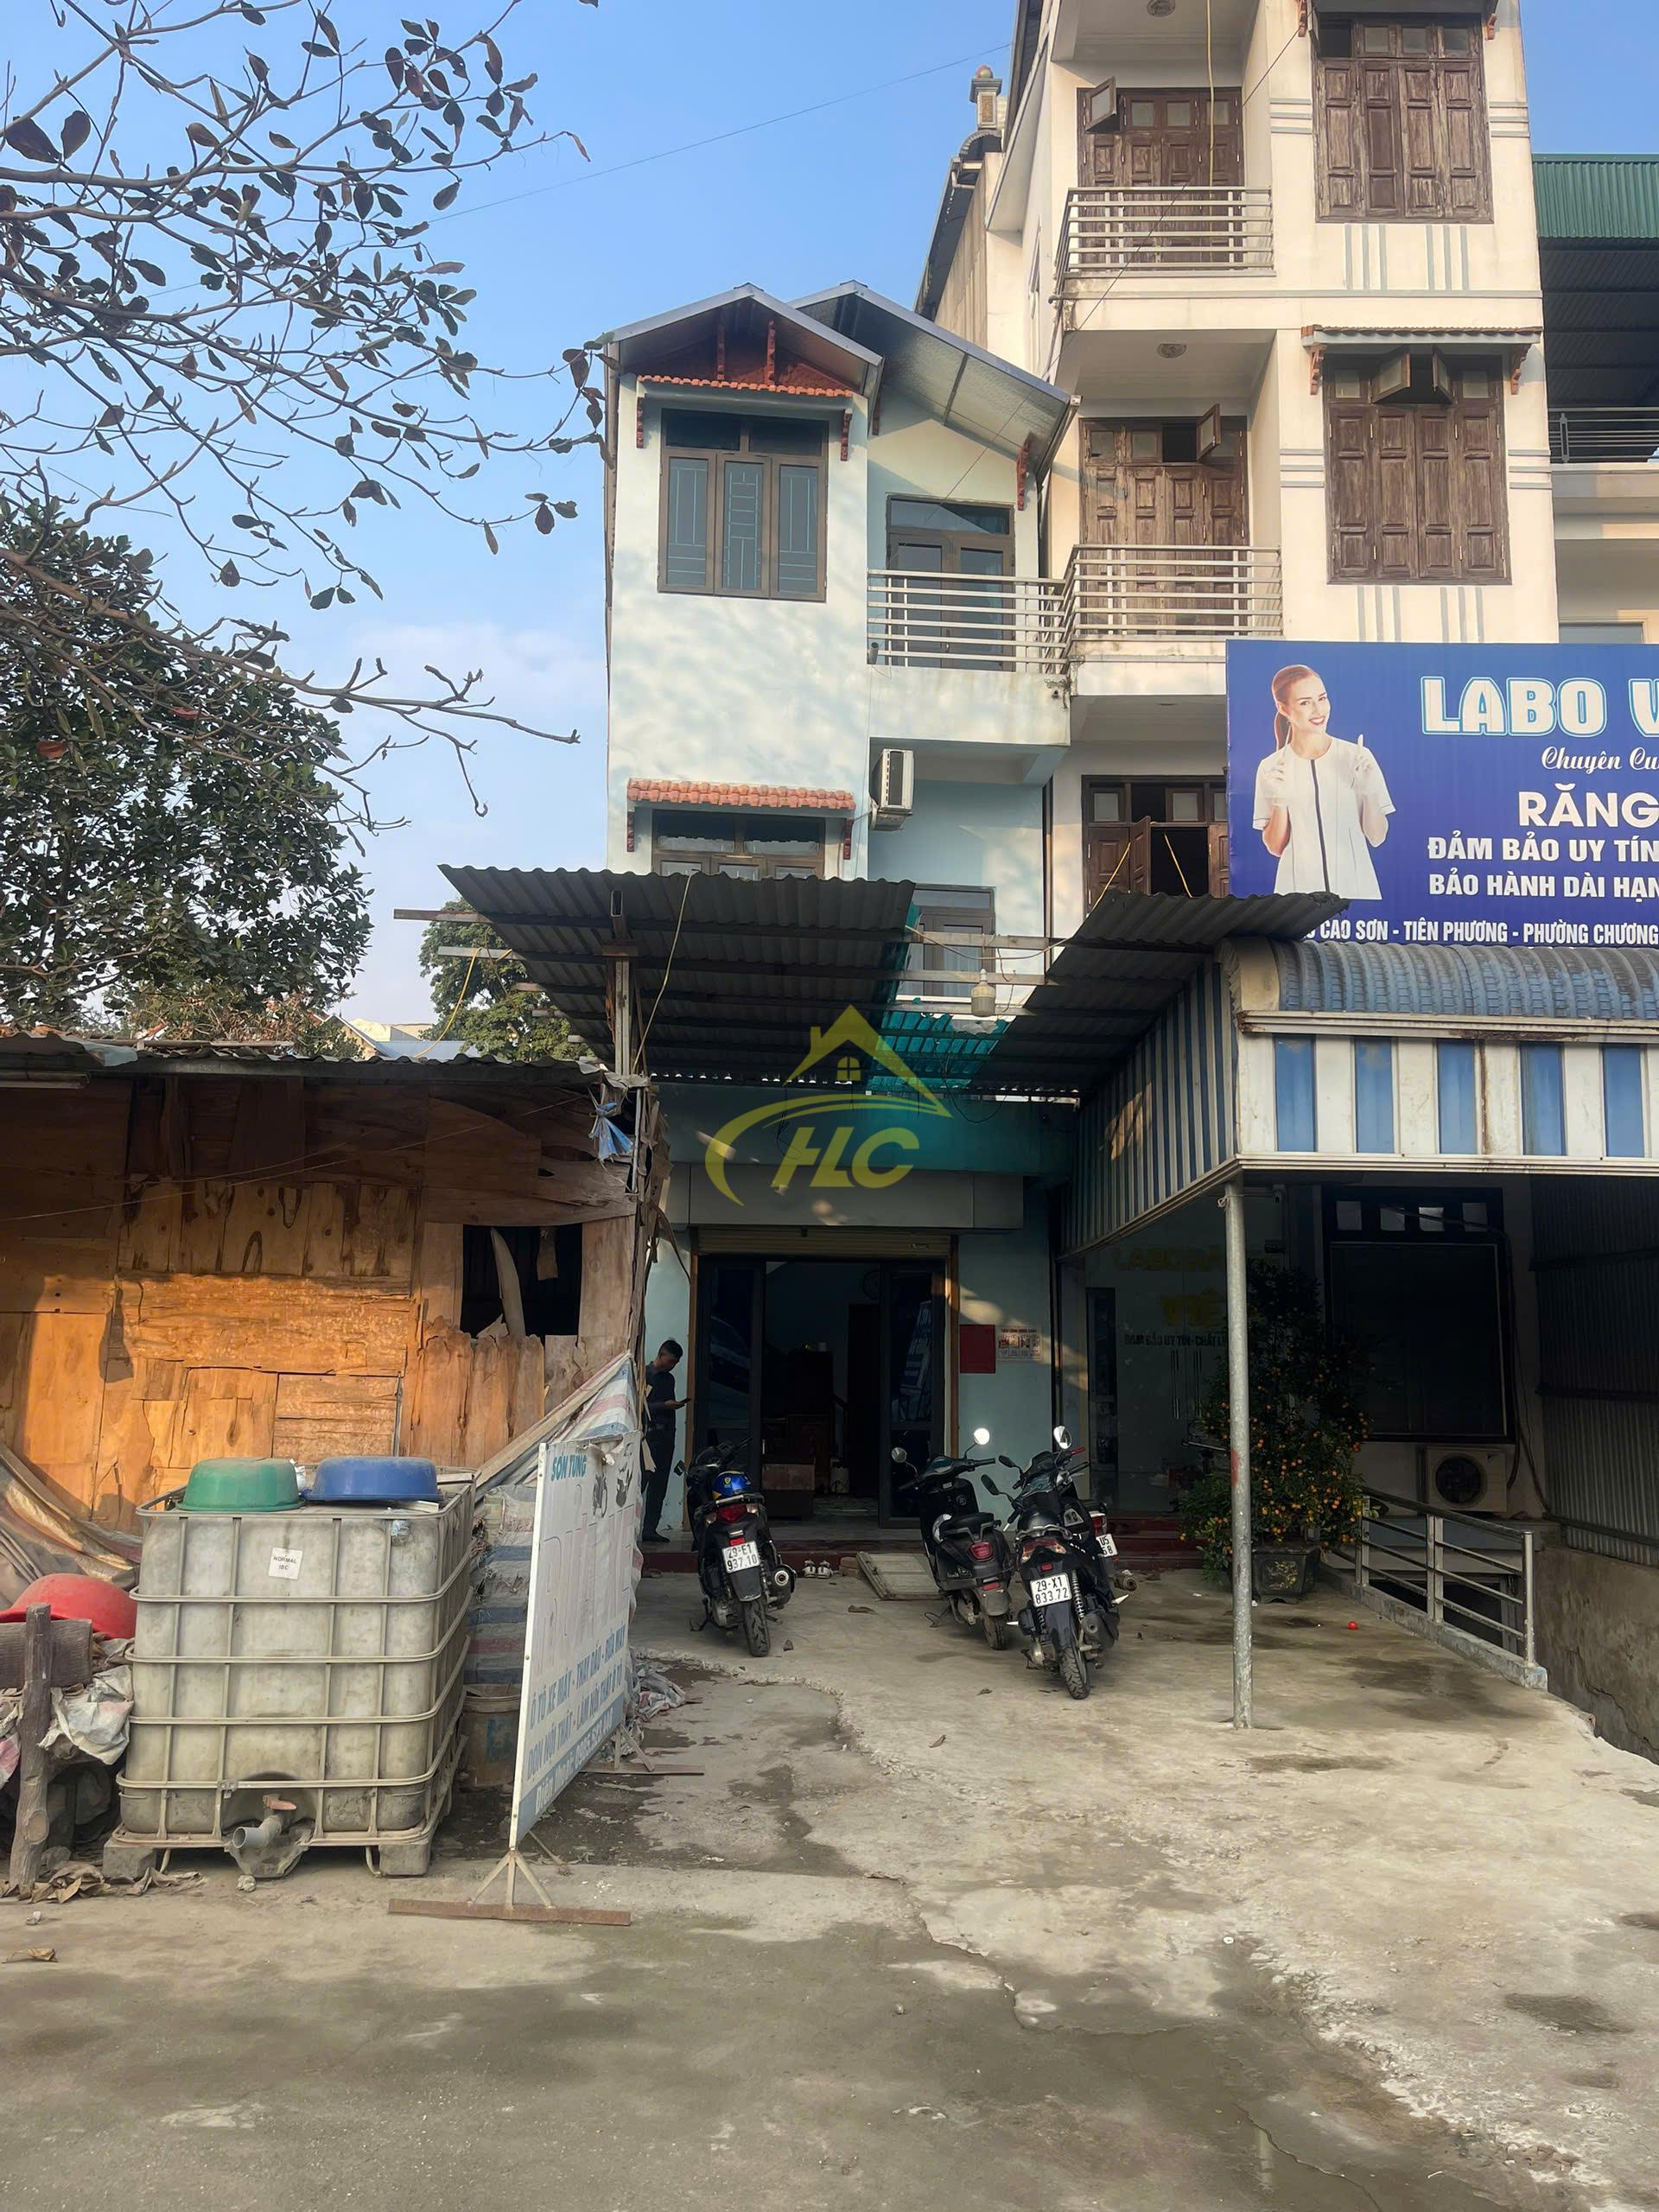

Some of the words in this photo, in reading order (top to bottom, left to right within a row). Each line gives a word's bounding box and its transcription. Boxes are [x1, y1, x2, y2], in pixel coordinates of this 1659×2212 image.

[1421, 676, 1607, 737] LABO
[1541, 746, 1622, 774] Chuyên
[1518, 783, 1659, 829] RĂNG
[1427, 830, 1492, 860] ĐẢM
[1502, 831, 1560, 861] BẢO
[1568, 839, 1605, 861] UY
[1613, 835, 1659, 862] TÍN
[1429, 868, 1479, 896] BẢO
[1486, 871, 1555, 897] HÀNH
[1563, 873, 1605, 898] DÀI
[1319, 919, 1351, 939] CAO
[1356, 918, 1389, 941] SƠN
[1403, 918, 1441, 941] TIÊN
[1443, 919, 1508, 943] PHƯƠNG
[1523, 919, 1589, 944] PHƯỜNG
[1593, 922, 1659, 945] CHƯƠNG
[1035, 1587, 1069, 1605] 833.72
[1036, 1576, 1063, 1592] 29-X1
